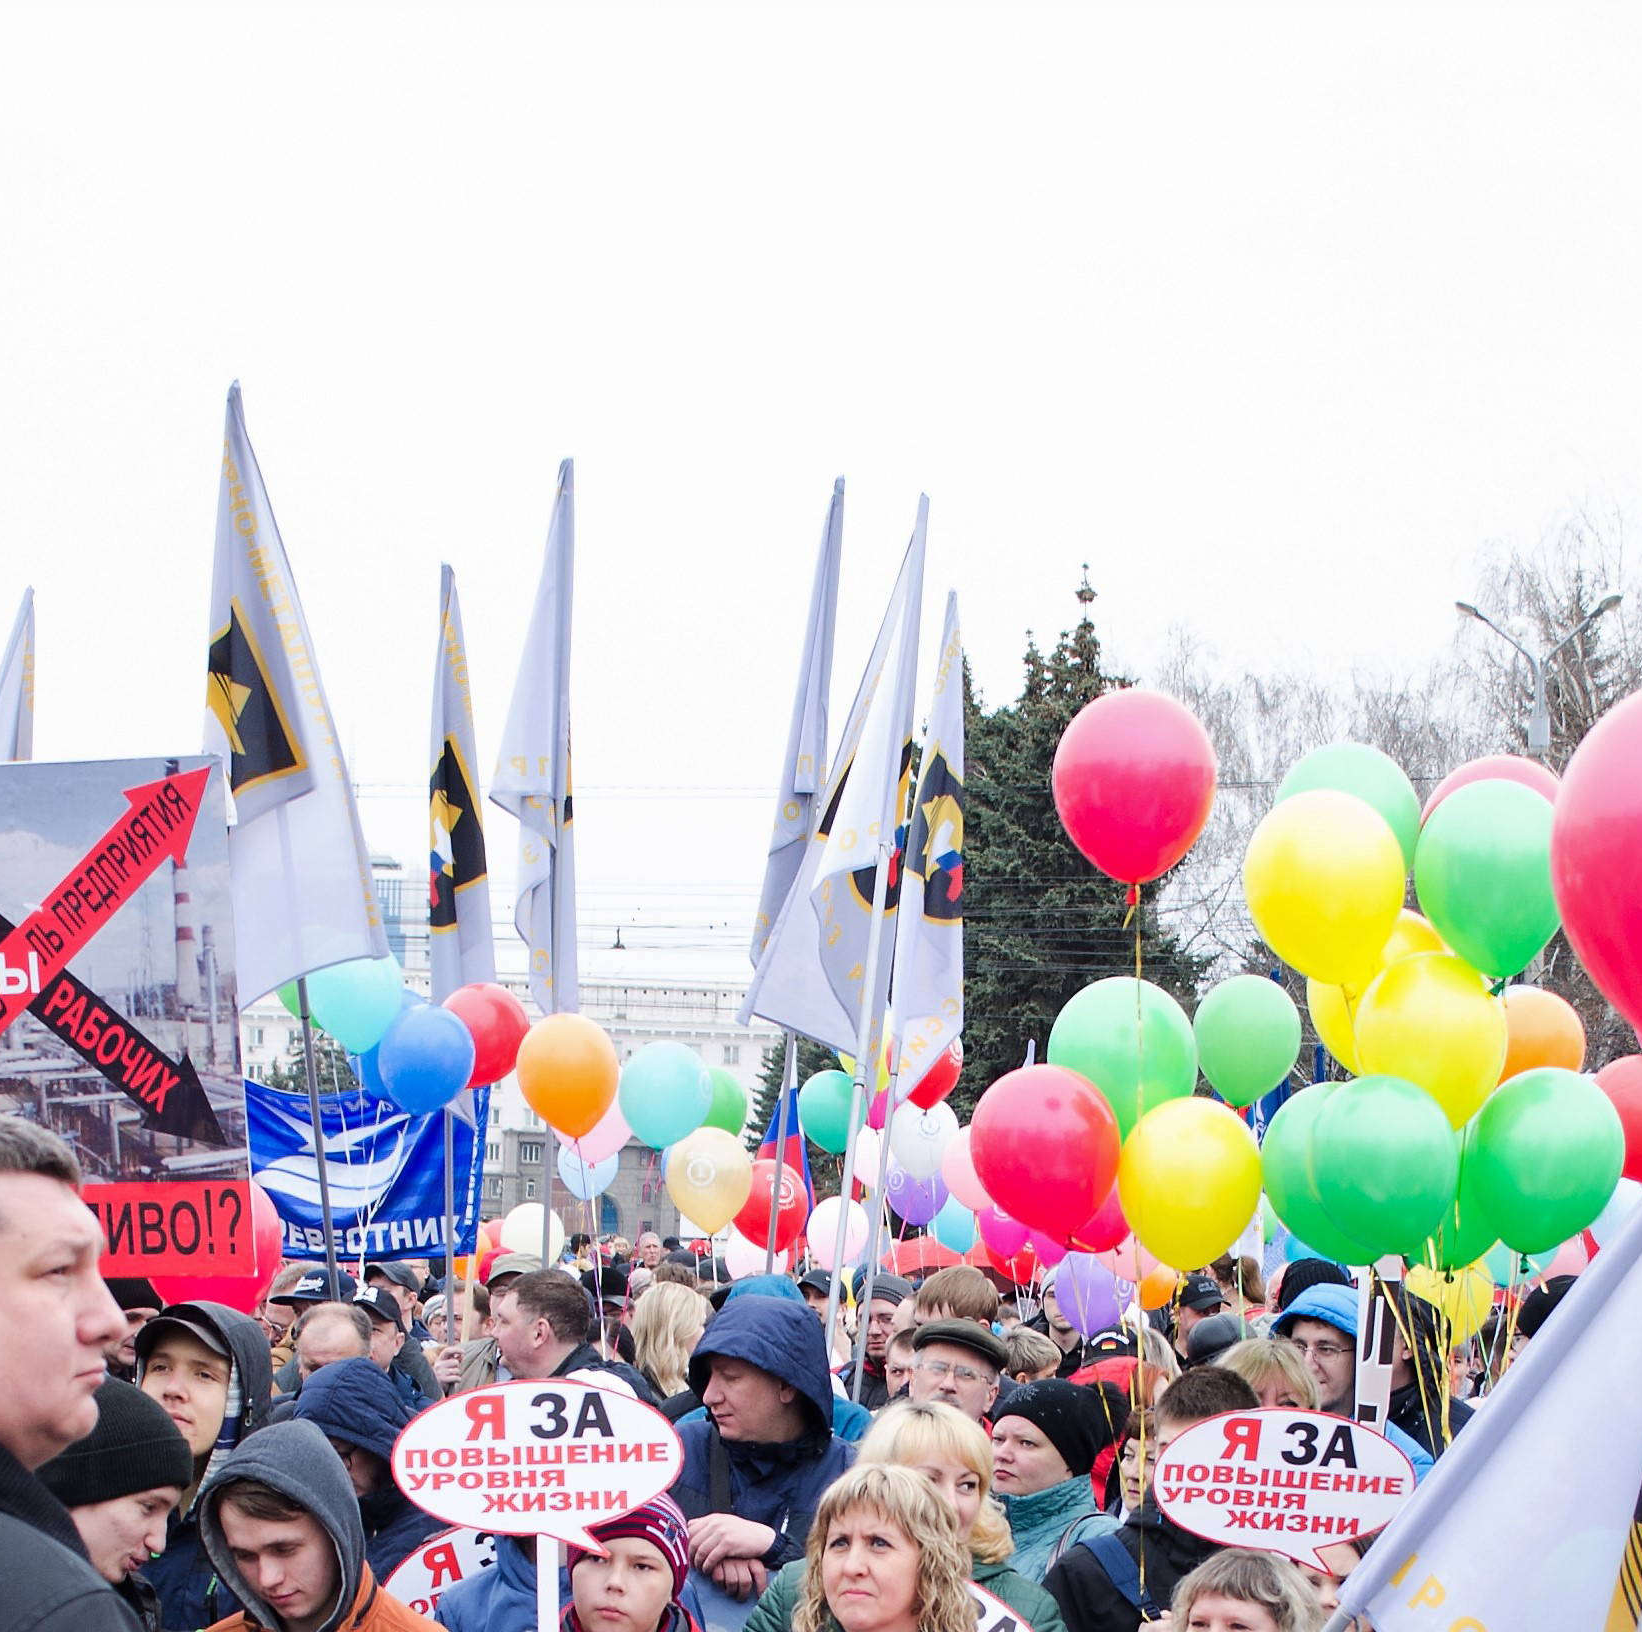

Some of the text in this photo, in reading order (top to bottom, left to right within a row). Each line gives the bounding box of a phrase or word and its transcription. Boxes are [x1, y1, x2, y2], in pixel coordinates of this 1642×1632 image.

[52, 782, 193, 929] ПРЕДПРИЯТИЯ
[42, 980, 181, 1113] РАБОЧИХ
[465, 1393, 613, 1440] Я ЗА
[405, 1443, 669, 1468] ПОВЫШЕНИЕ
[1221, 1418, 1357, 1469] Я ЗА
[408, 1468, 565, 1491] УРОВНЯ
[1163, 1464, 1404, 1496] ПОВЫШЕНИЕ
[482, 1488, 629, 1514] ЖИЗНИ
[1163, 1486, 1306, 1511] УРОВНЯ
[1225, 1510, 1360, 1536] ЖИЗНИ
[423, 1542, 463, 1588] Я
